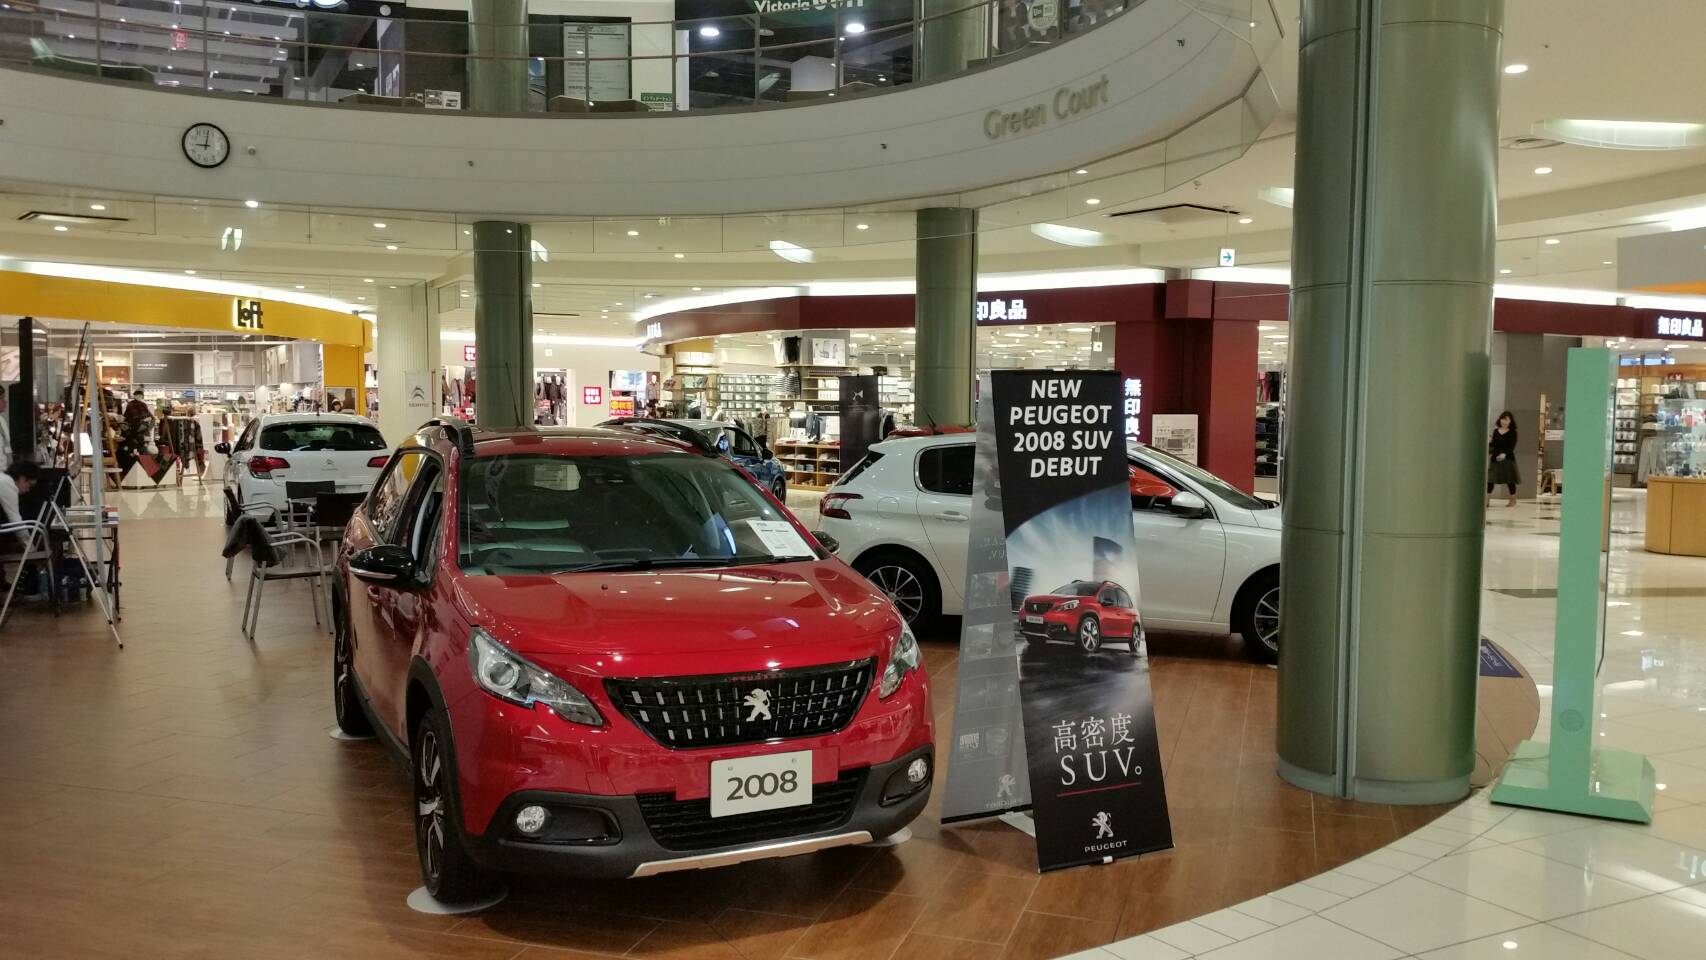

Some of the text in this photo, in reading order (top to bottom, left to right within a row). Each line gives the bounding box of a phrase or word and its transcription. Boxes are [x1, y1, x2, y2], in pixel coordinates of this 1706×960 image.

[983, 73, 1109, 140] Green Court
[976, 298, 1028, 321] 印良品
[1657, 315, 1704, 337] 無印良品
[1030, 379, 1082, 399] NEW
[1009, 404, 1112, 426] PEUGEOT
[1124, 378, 1142, 442] 無印良
[1013, 430, 1113, 452] 2008 SUV
[1030, 456, 1103, 478] DEBUT
[1052, 712, 1136, 754] 高密度
[726, 769, 798, 801] 2008
[1084, 840, 1128, 853] PEUGEOT
